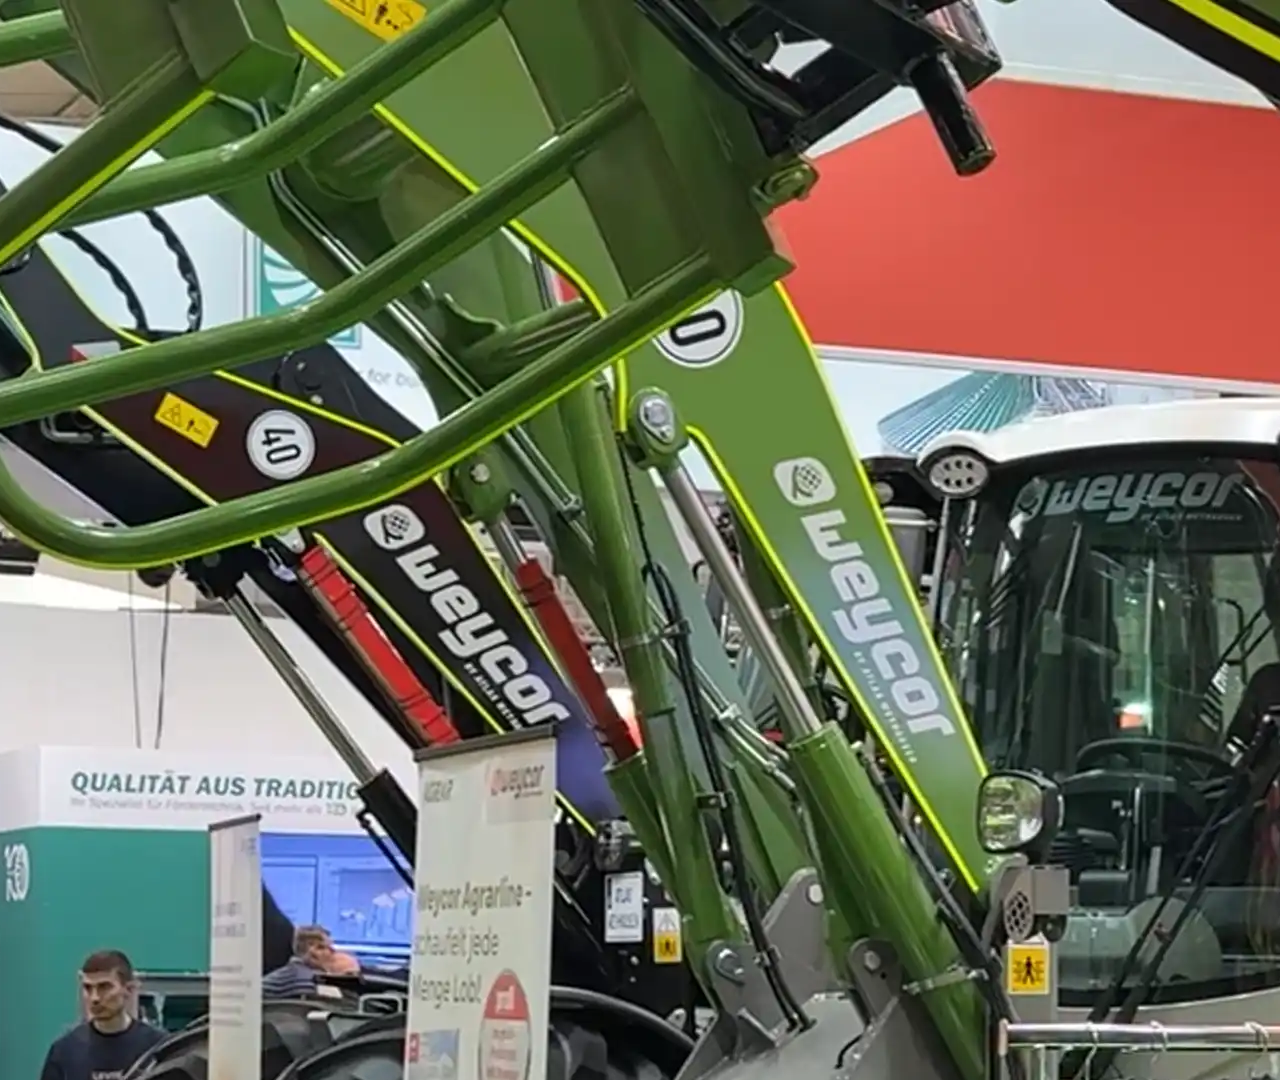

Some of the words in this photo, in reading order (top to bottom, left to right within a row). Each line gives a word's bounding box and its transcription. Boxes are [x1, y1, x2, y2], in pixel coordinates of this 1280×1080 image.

[261, 428, 301, 464] 40
[1043, 472, 1245, 523] weycor
[395, 544, 570, 725] weycor
[800, 509, 956, 736] weycor
[70, 769, 190, 796] QUALITÄT
[196, 777, 246, 796] AUS
